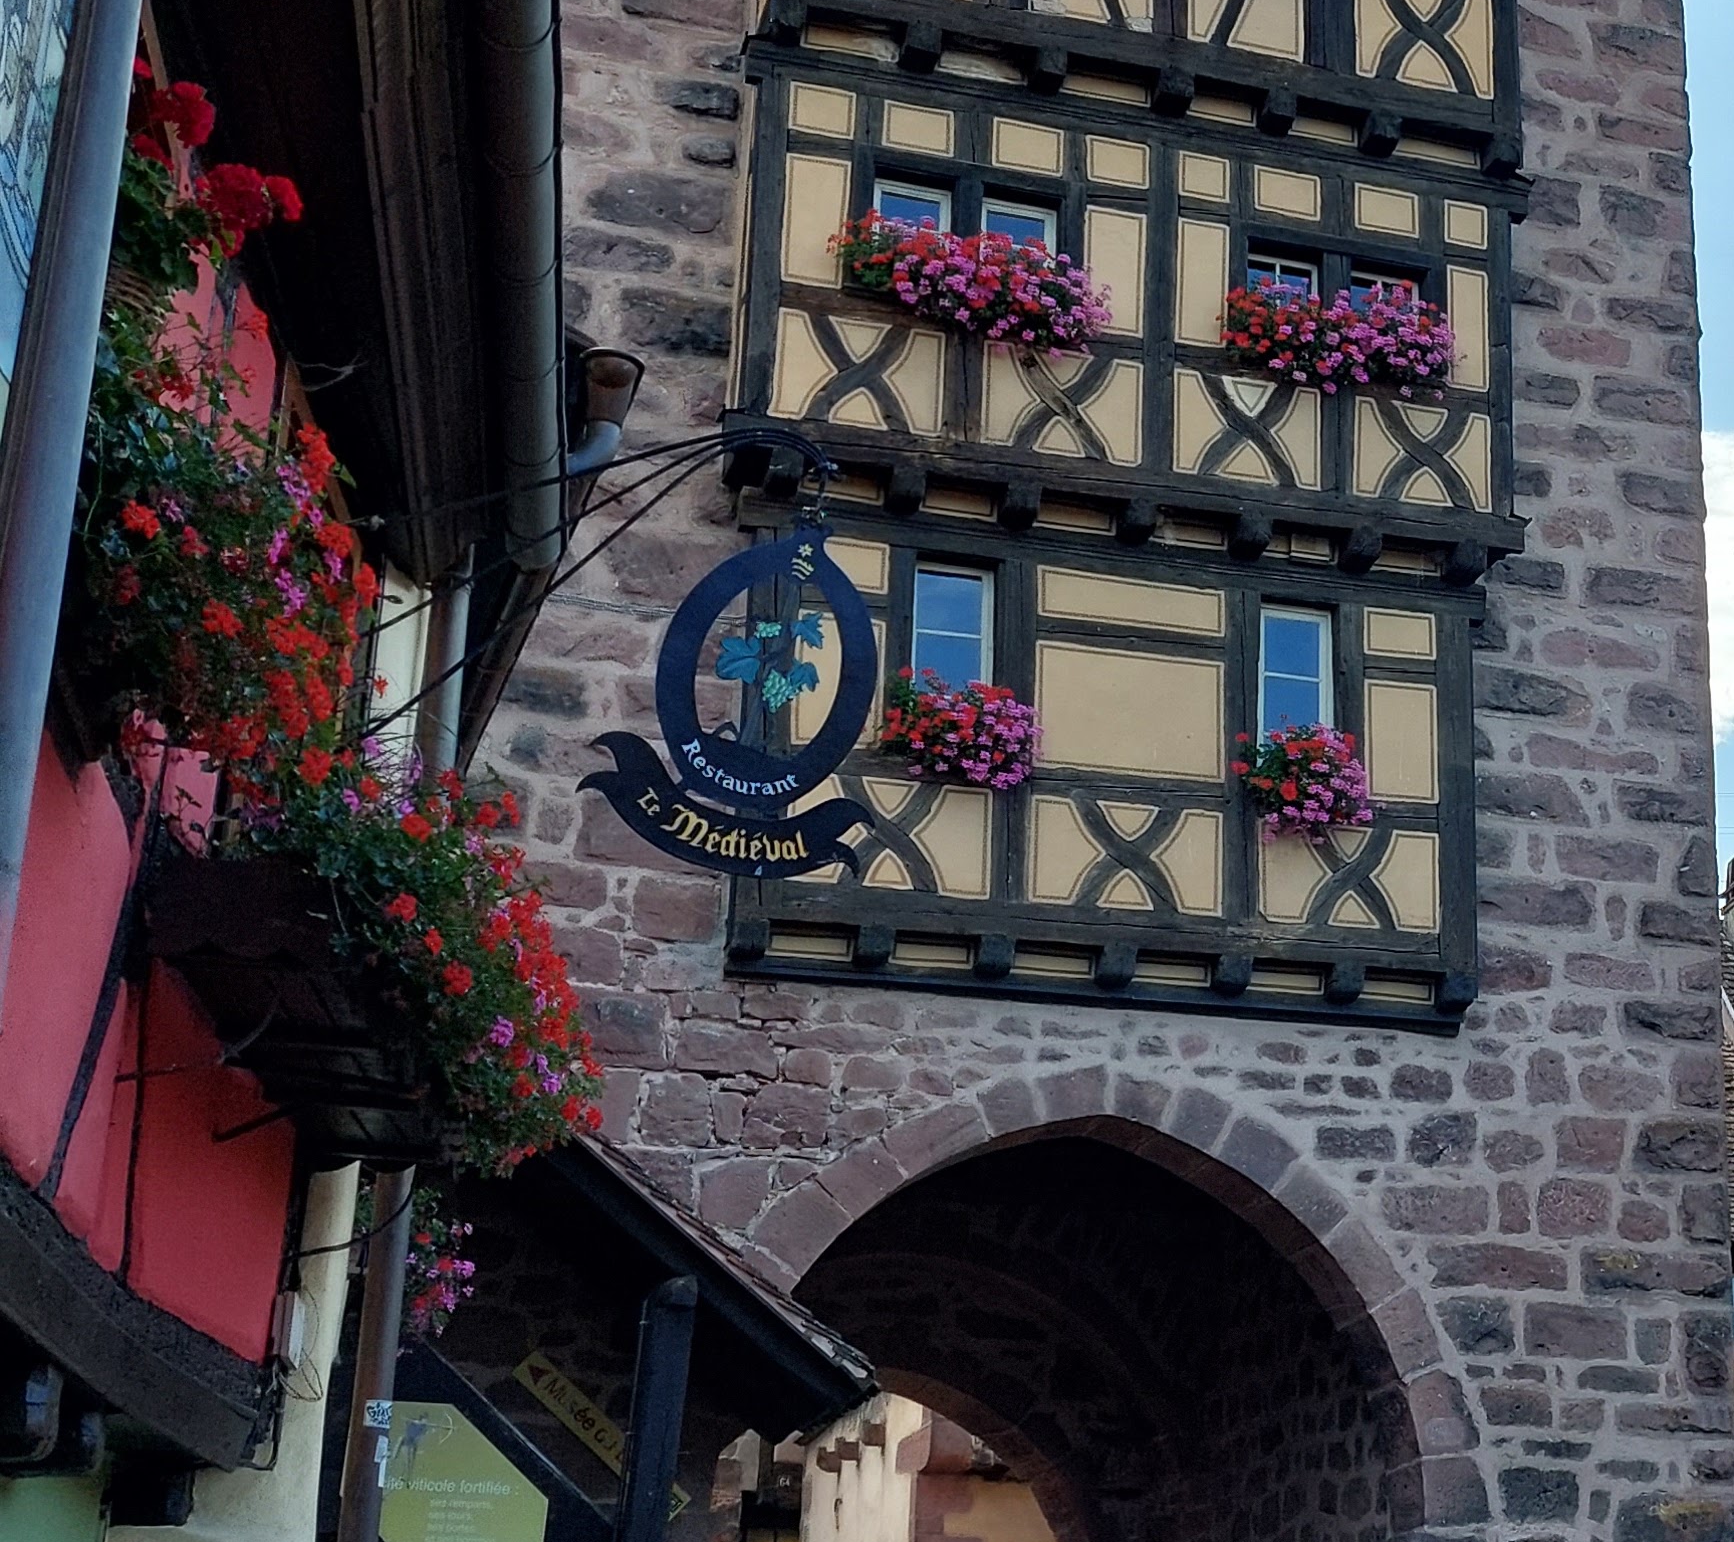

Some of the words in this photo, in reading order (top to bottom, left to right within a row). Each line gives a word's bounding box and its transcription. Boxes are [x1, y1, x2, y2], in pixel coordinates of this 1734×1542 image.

[681, 737, 800, 797] Restaurant
[636, 787, 662, 817] Le
[661, 804, 810, 862] Médiéval
[408, 1478, 456, 1493] viticole
[459, 1481, 511, 1495] fortifiée
